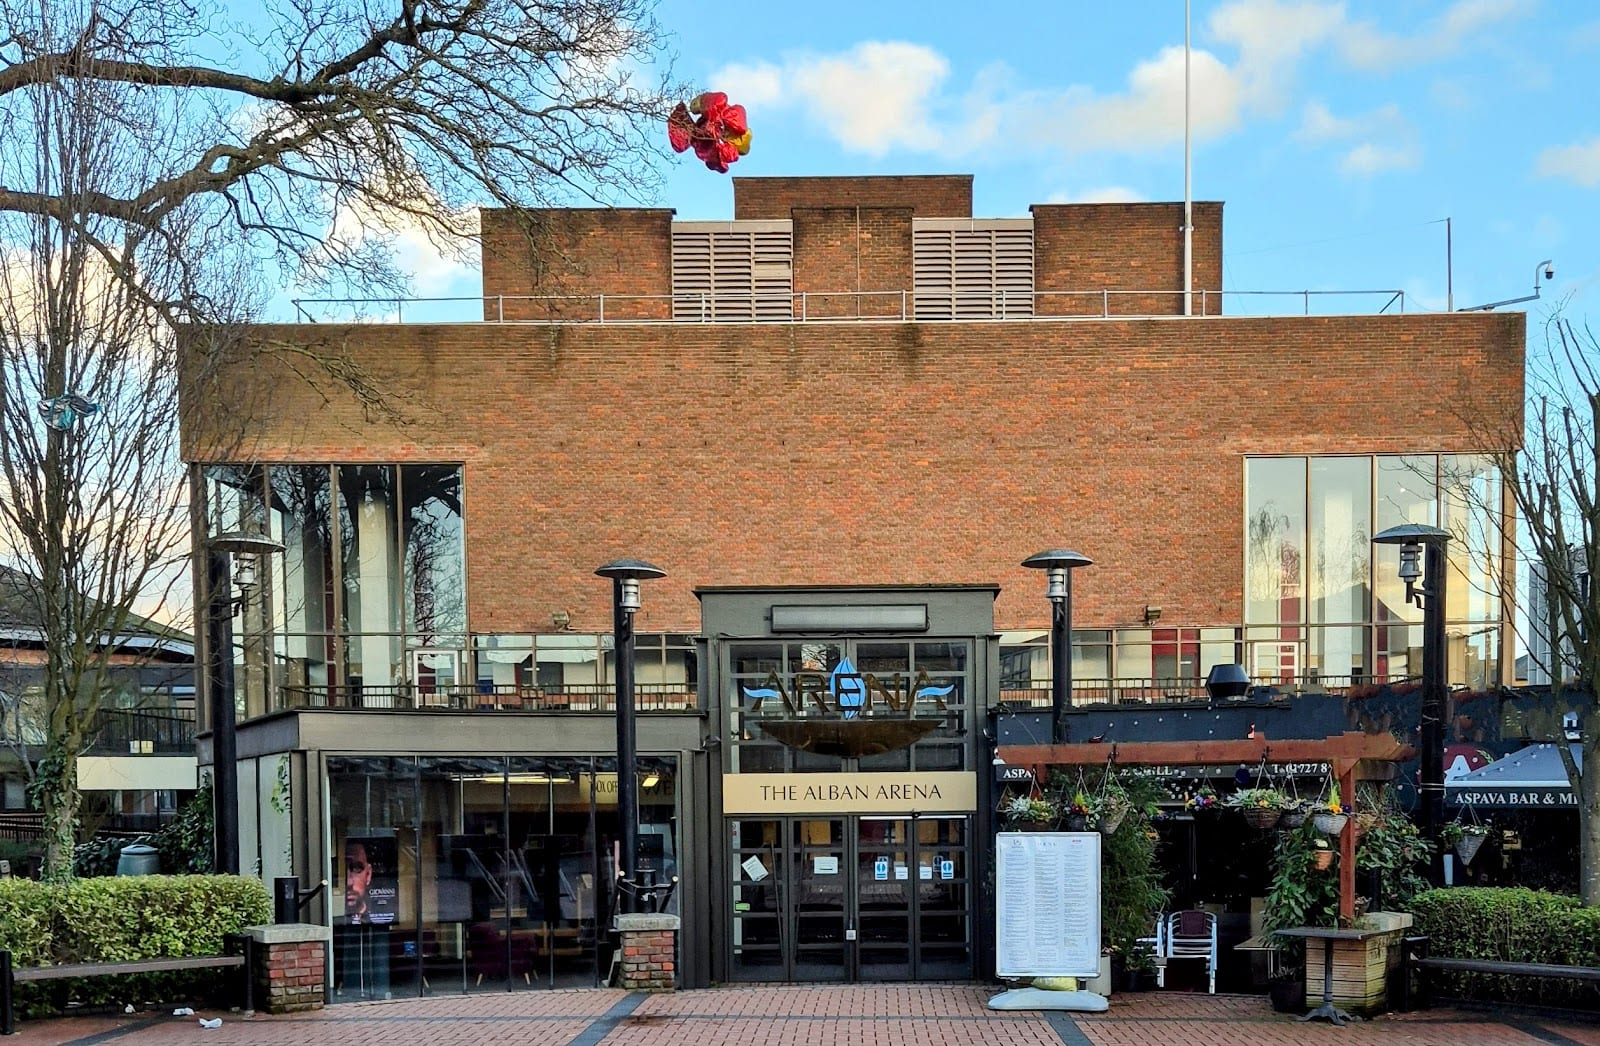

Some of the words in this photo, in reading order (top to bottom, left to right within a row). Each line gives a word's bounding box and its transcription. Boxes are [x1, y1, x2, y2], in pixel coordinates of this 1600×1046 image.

[752, 667, 947, 712] ARENA
[1003, 768, 1032, 779] ASPA
[760, 785, 797, 801] THE
[804, 785, 869, 801] ALBAN
[876, 784, 942, 800] ARENA
[1455, 792, 1506, 805] ASPAVA
[1509, 792, 1539, 805] BAR
[1543, 792, 1555, 805] &
